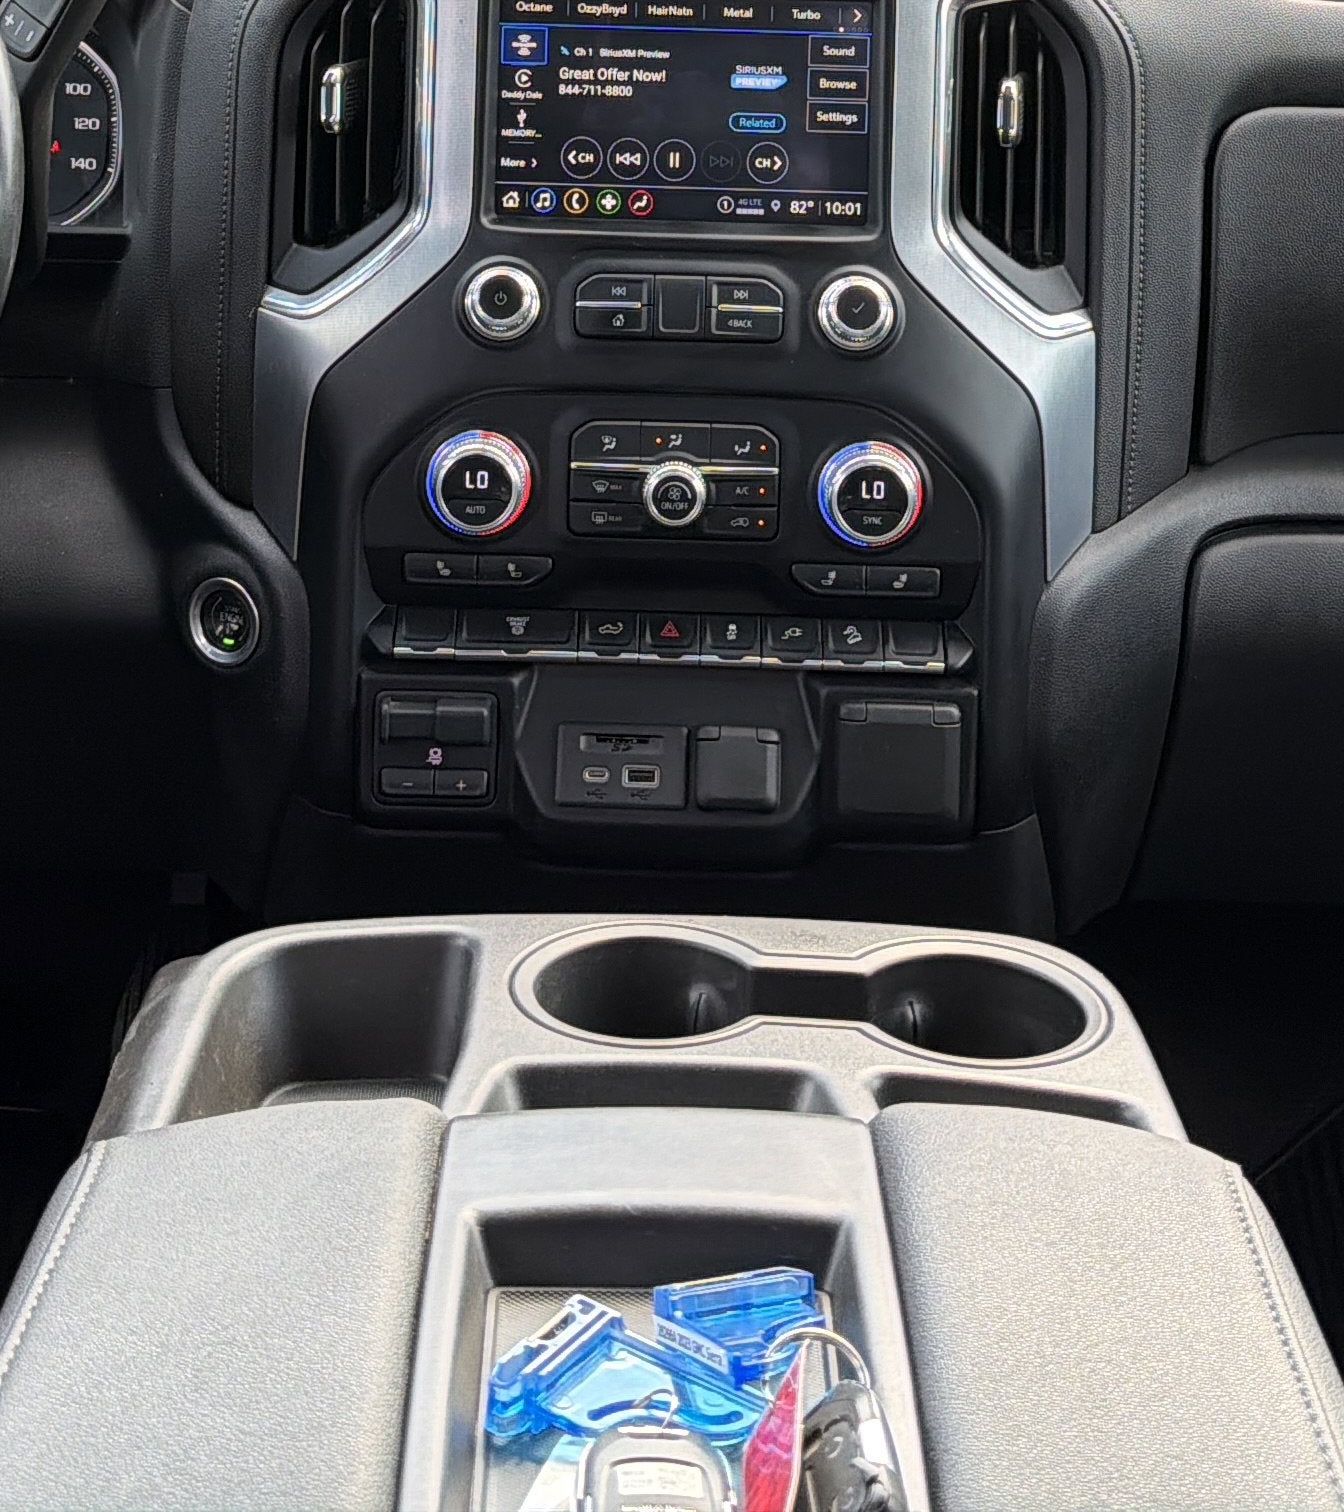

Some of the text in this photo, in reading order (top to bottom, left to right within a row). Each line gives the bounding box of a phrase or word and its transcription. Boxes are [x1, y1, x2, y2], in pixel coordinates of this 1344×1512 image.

[516, 1, 821, 21] Octane OzzyBnyd HairNatn Metal Turbo
[574, 47, 586, 58] Ch
[637, 49, 670, 60] Preview
[823, 45, 855, 57] Sound
[559, 67, 666, 83] Great Offer Now!
[65, 83, 91, 95] 100
[820, 78, 856, 91] Browse
[502, 91, 543, 101] Daddy Dale
[559, 85, 633, 97] 844-711-8800
[74, 118, 101, 130] 120
[740, 117, 775, 129] Related
[817, 111, 857, 125] Settings
[70, 158, 97, 170] 140
[501, 157, 525, 168] More
[579, 152, 594, 164] CH
[755, 158, 771, 169] CH
[790, 201, 814, 214] 82°
[825, 201, 862, 215] 10:01
[734, 318, 753, 329] BACK
[465, 471, 489, 490] LO
[736, 487, 749, 495] A/C
[861, 481, 885, 500] LO
[465, 504, 486, 515] AUTO
[661, 502, 689, 510] ON/OFF
[862, 515, 883, 526] SYNC
